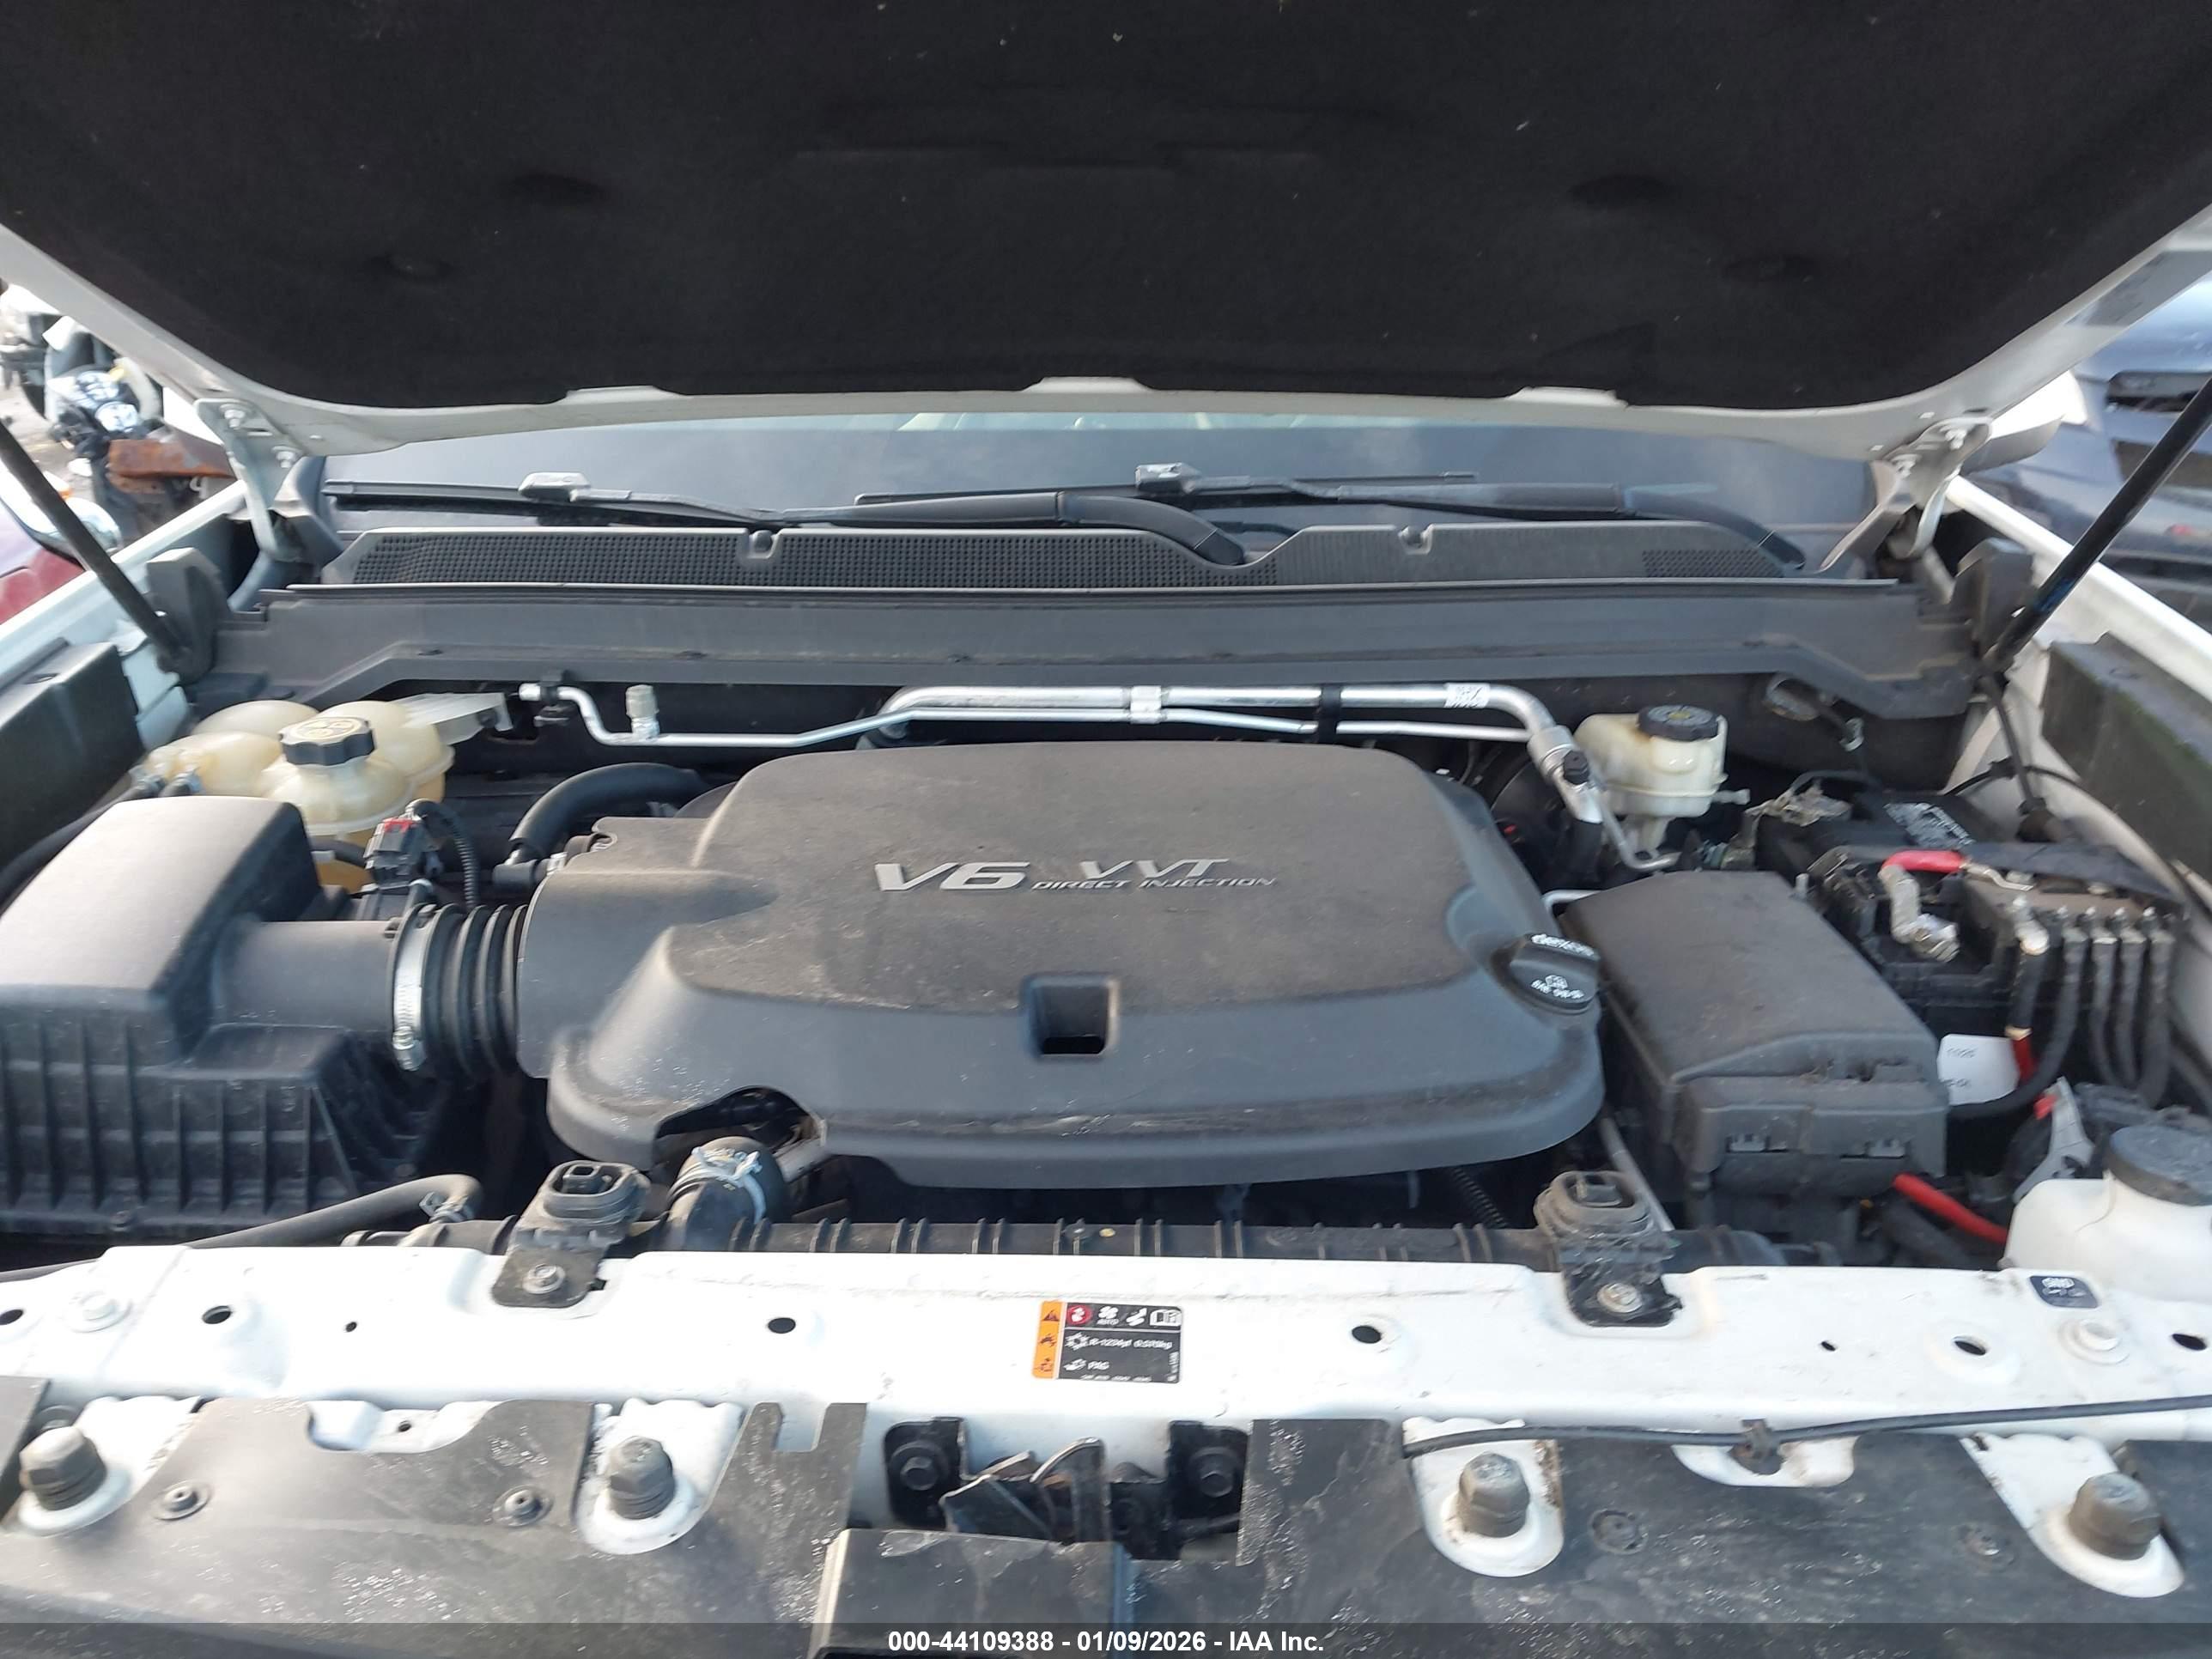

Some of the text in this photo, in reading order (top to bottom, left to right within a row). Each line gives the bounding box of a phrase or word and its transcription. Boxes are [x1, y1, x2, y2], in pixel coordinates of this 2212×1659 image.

[874, 858, 1231, 891] V6 VVT
[1031, 877, 1276, 890] DIRECT INJECTION
